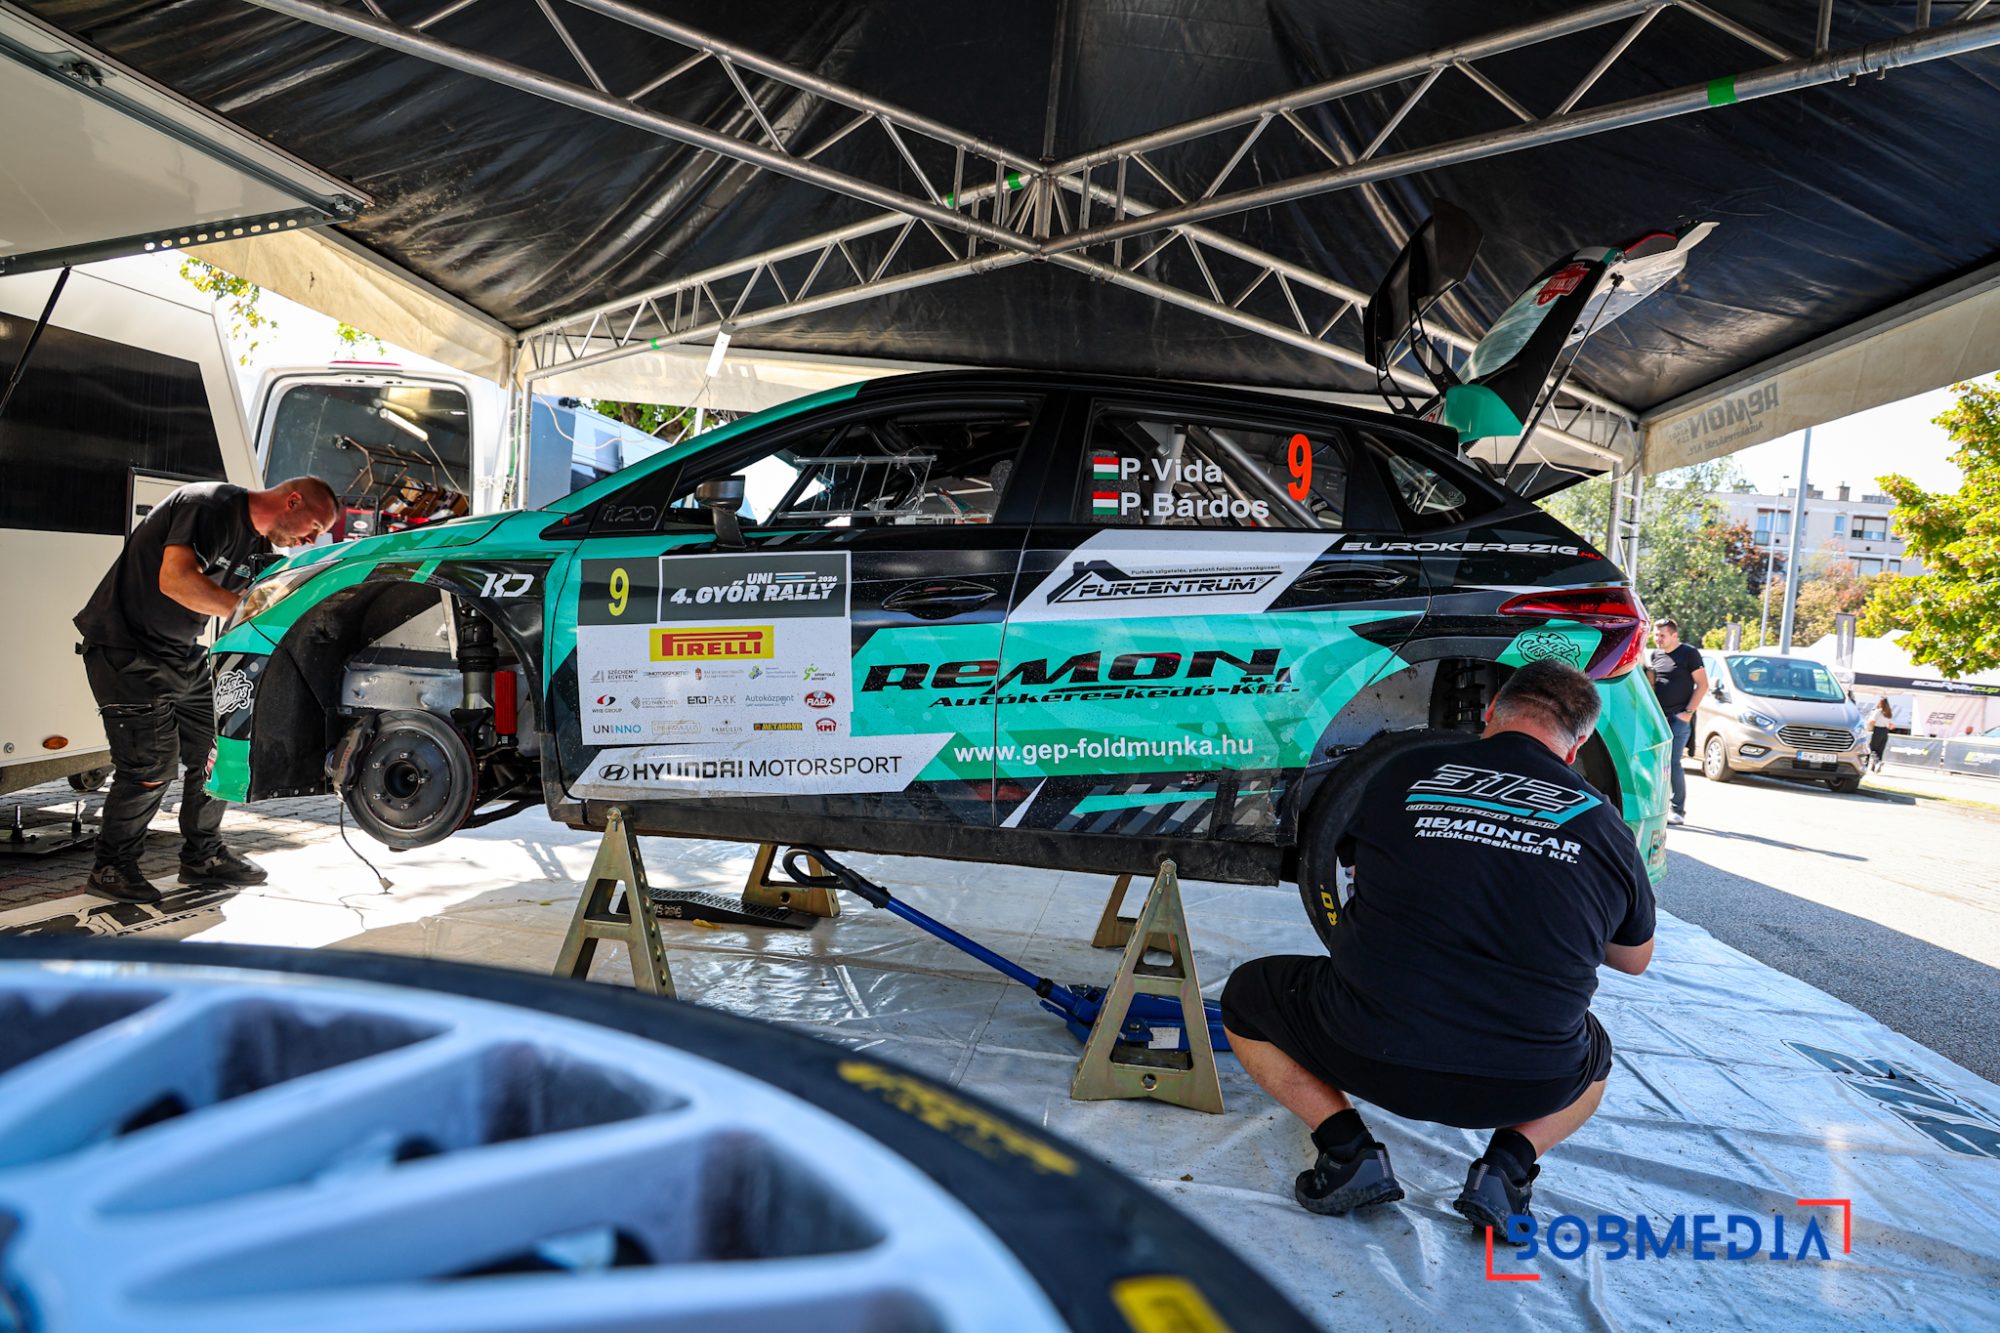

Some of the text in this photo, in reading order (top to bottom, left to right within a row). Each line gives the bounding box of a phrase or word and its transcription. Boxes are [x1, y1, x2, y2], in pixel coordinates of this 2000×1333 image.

[1287, 434, 1313, 501] 9
[608, 567, 629, 616] 9
[747, 572, 773, 585] UNI
[1079, 577, 1257, 598] PURCENTRUM
[763, 583, 837, 602] RALLY
[662, 631, 763, 657] PIRELLI
[954, 735, 1253, 765] www.gep-foldmunka.hu
[633, 755, 903, 781] HYUNDAI MOTORSPORT
[1548, 849, 1578, 864] Kft.
